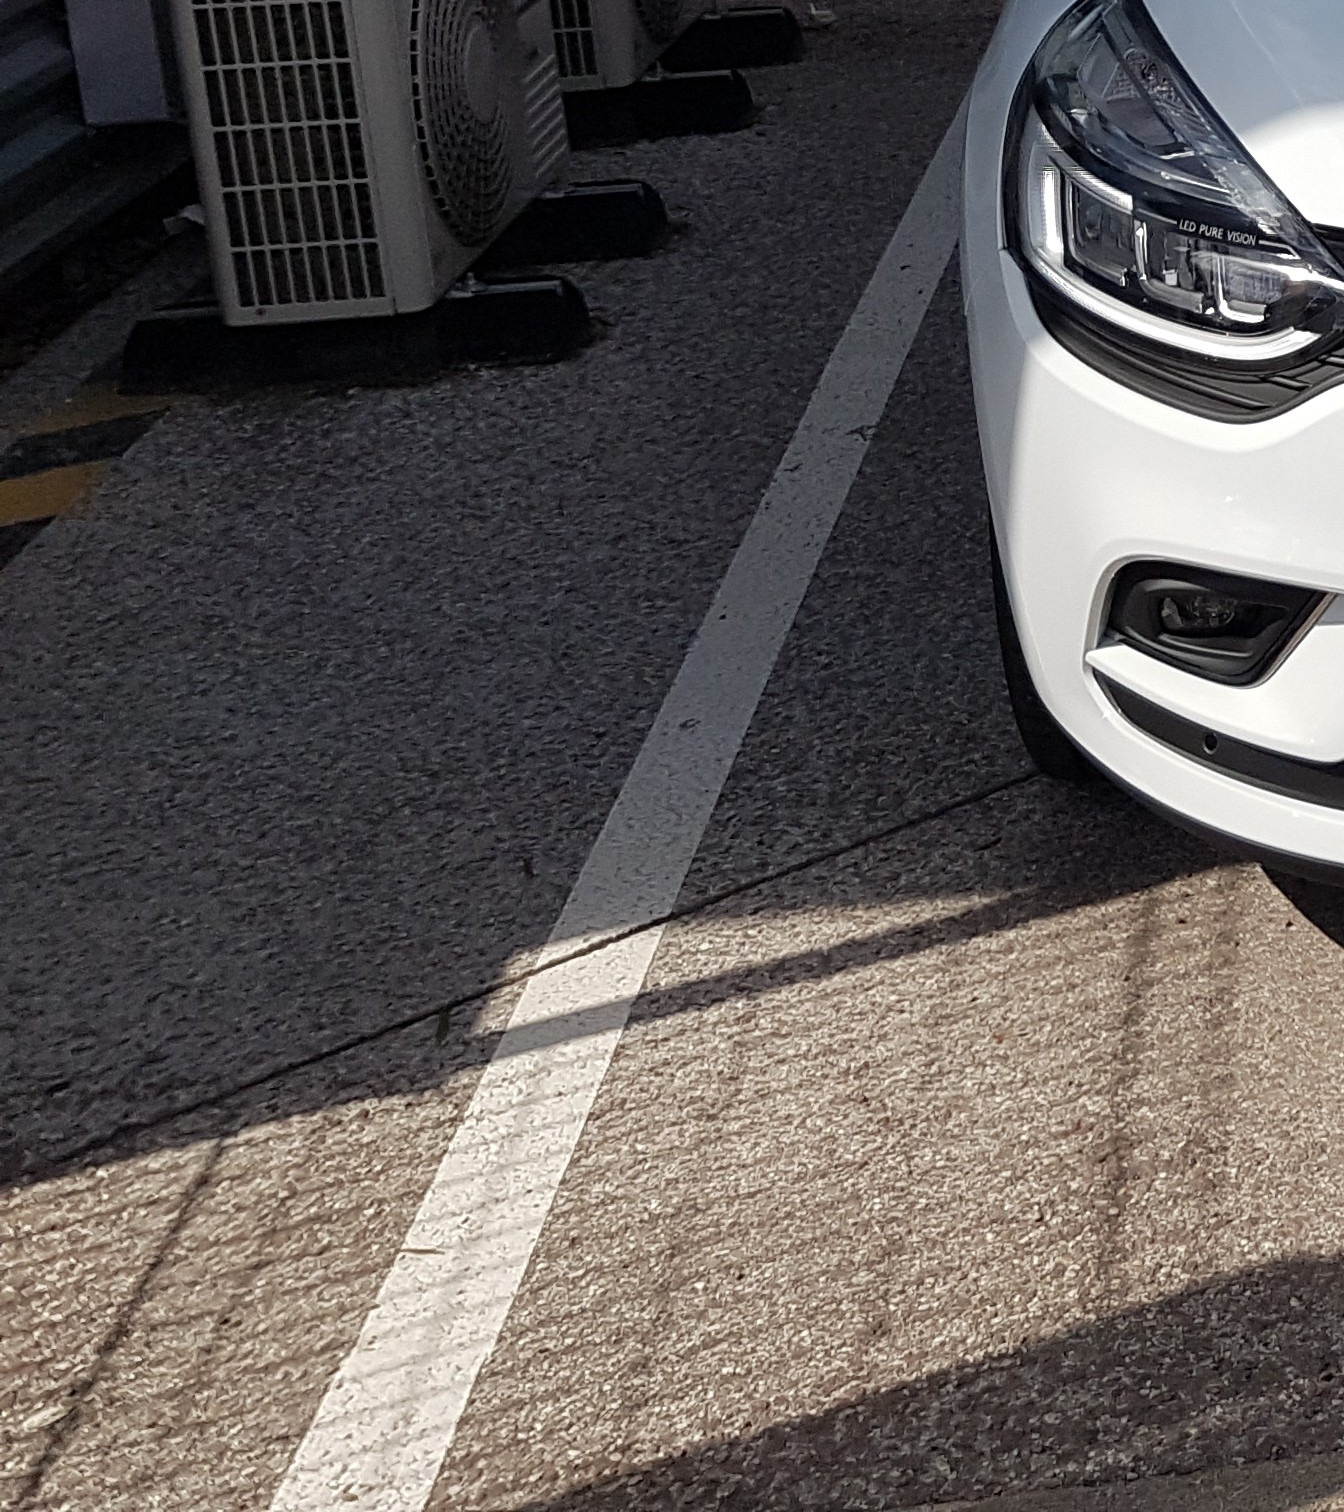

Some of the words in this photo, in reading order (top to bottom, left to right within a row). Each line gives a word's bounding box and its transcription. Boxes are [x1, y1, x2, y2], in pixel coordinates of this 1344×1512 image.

[1179, 219, 1197, 232] LED
[1199, 224, 1224, 239] PURE
[1227, 230, 1257, 246] VISION
